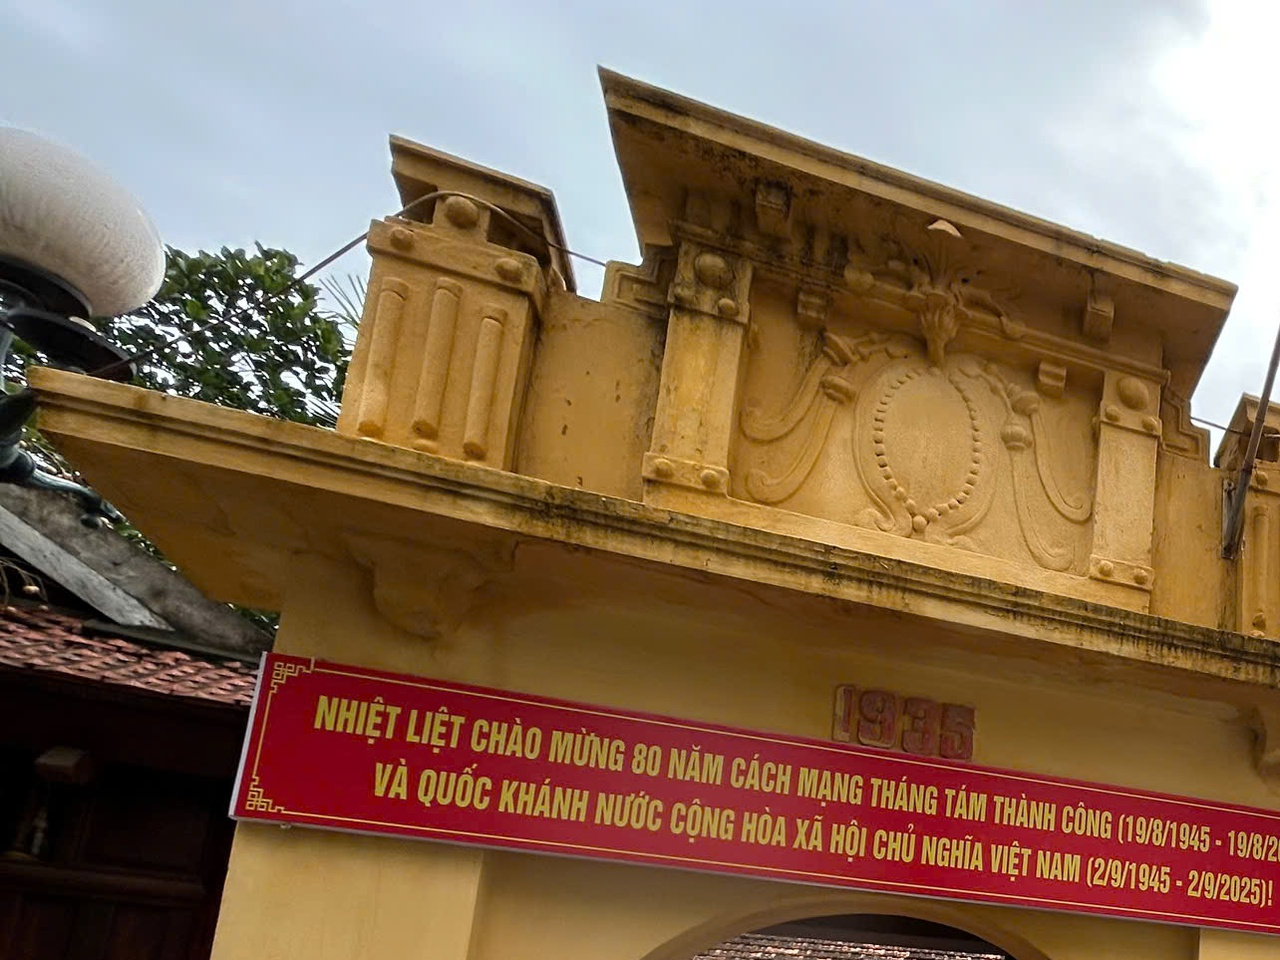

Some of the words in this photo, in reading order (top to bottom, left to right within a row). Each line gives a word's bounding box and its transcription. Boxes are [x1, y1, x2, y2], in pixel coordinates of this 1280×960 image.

[313, 696, 402, 745] NHIỆT
[405, 706, 466, 754] LIỆT
[470, 717, 543, 760] CHÀO
[548, 727, 626, 772] MỪNG
[631, 742, 663, 777] 80
[667, 744, 725, 786] NĂM
[729, 754, 793, 796] CÁCH
[796, 766, 864, 808] MẠNG
[870, 776, 939, 816] THÁNG
[944, 784, 988, 822] TÁM
[993, 792, 1057, 832] THÀNH
[1061, 801, 1113, 840] CÔNG
[1117, 813, 1211, 853] (19/8/1945
[831, 684, 976, 761] 1935
[374, 758, 408, 800] VÀ
[417, 763, 493, 810] QUỐC
[497, 777, 590, 823] KHÁNH
[593, 790, 665, 832] NƯỚC
[669, 797, 736, 844] CỘNG
[740, 806, 787, 848] HÒA
[791, 814, 824, 852] XÃ
[829, 819, 868, 863] HỘI
[872, 823, 917, 863] CHỦ
[920, 834, 984, 872] NGHĨA
[990, 840, 1033, 882] VIỆT
[1035, 849, 1082, 883] NAM
[1086, 856, 1171, 894] (2/9/1945
[1187, 869, 1273, 908] 2/9/2025)!
